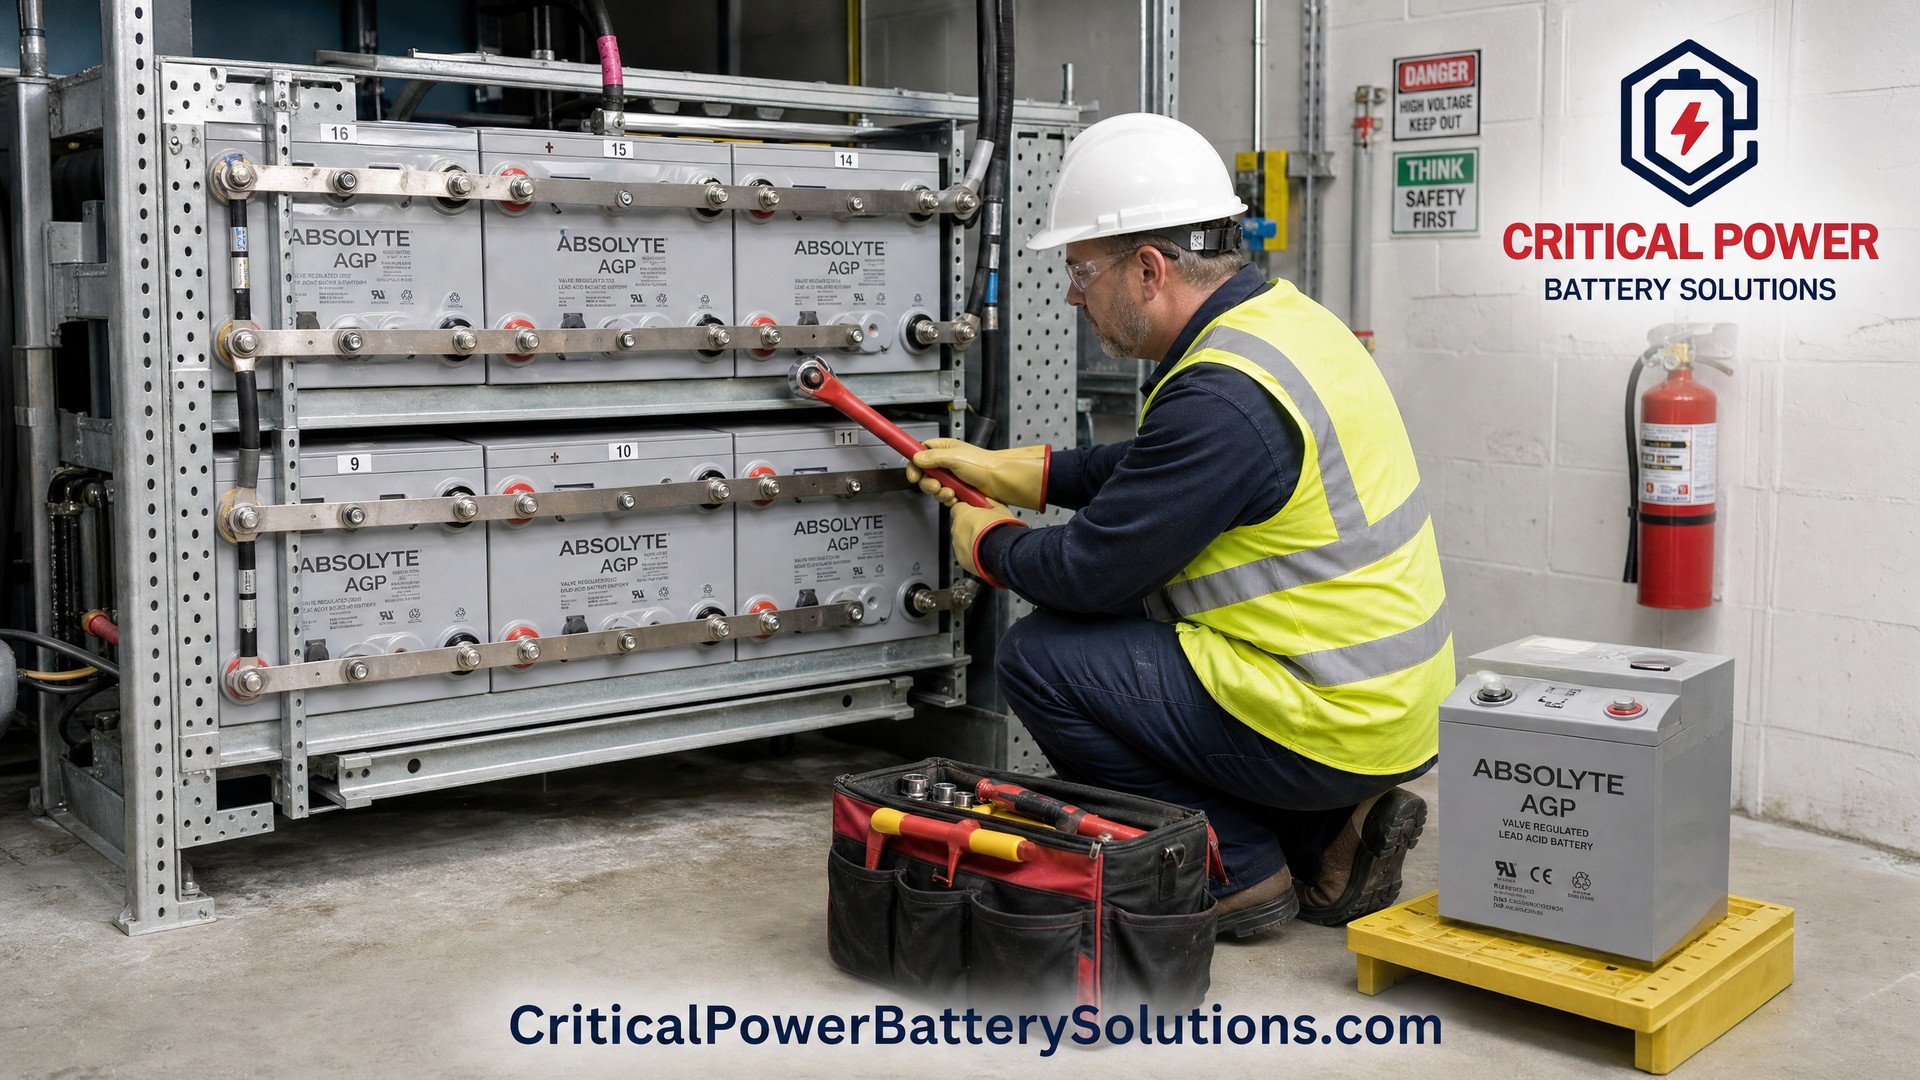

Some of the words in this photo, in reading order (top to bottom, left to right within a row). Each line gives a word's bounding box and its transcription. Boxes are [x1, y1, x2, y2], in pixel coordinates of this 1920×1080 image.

[1404, 60, 1469, 87] DANGER
[1400, 98, 1425, 113] HIGH
[1427, 94, 1473, 112] VOLTAGE
[1409, 119, 1436, 132] KEEP
[1440, 115, 1462, 130] OUT
[331, 126, 349, 141] 16
[611, 142, 627, 157] 15
[839, 154, 853, 166] 14
[1406, 157, 1465, 182] THINK
[1406, 189, 1465, 208] SAFETY
[1413, 211, 1457, 228] FIRST
[292, 228, 411, 247] ABSOLYTE
[557, 236, 666, 254] ABSOLYTE
[794, 240, 886, 256] ABSOLYTE
[333, 252, 377, 269] AGP
[598, 259, 636, 274] AGP
[828, 261, 860, 275] AGP
[840, 432, 852, 443] 11
[616, 445, 631, 458] 10
[350, 457, 360, 471] 9
[793, 514, 884, 536] ABSOLYTE
[558, 533, 668, 557] ABSOLYTE
[827, 536, 859, 551] AGP
[300, 550, 419, 573] ABSOLYTE
[600, 556, 638, 574] AGP
[344, 575, 387, 593] AGP
[1472, 758, 1624, 796] ABSOLYTE
[1520, 794, 1576, 818] AGP
[1502, 818, 1531, 830] VALVE
[1533, 822, 1589, 838] REGULATED
[1499, 830, 1523, 841] LEAD
[1525, 834, 1548, 845] ACID
[1551, 837, 1594, 851] BATTERY
[1530, 866, 1552, 885] CE
